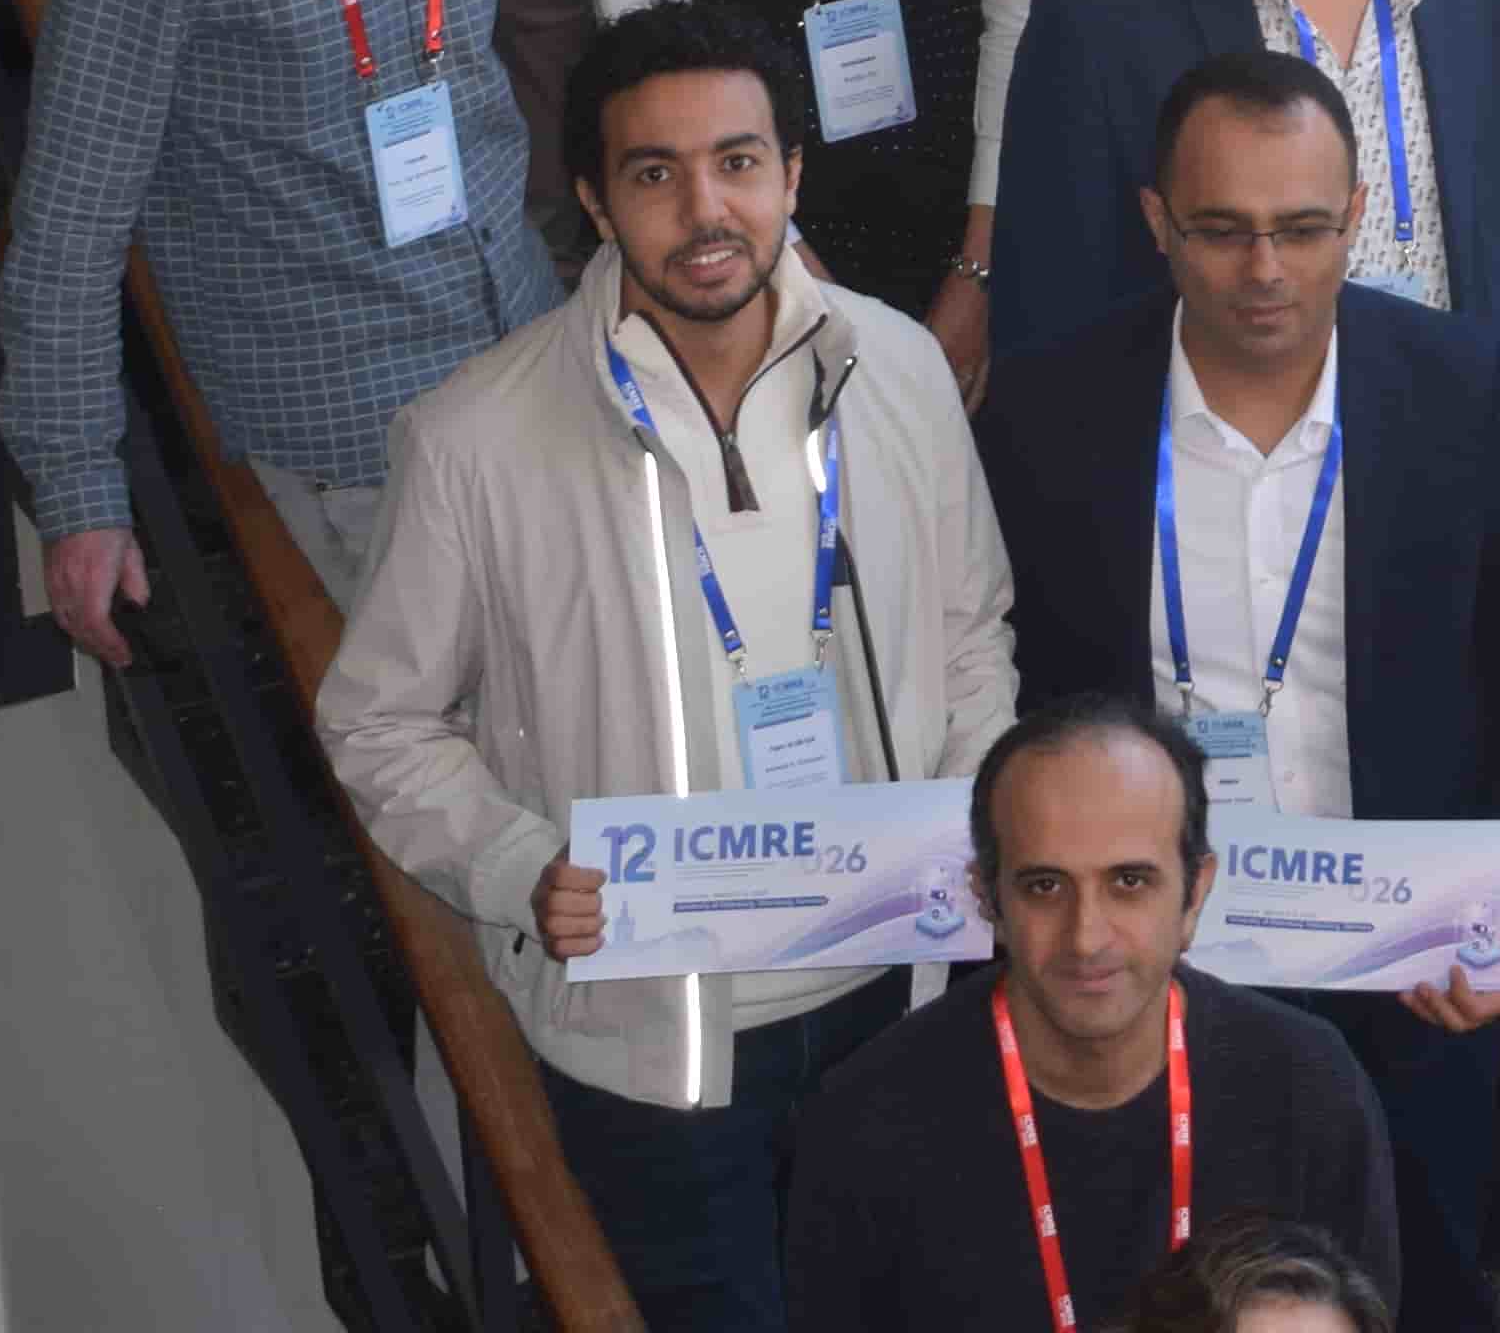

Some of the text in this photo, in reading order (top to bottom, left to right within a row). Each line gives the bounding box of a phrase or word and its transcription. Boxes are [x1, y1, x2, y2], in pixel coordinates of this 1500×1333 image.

[600, 823, 657, 884] 12
[674, 821, 816, 862] ICMRE
[1227, 844, 1365, 886] ICMRE
